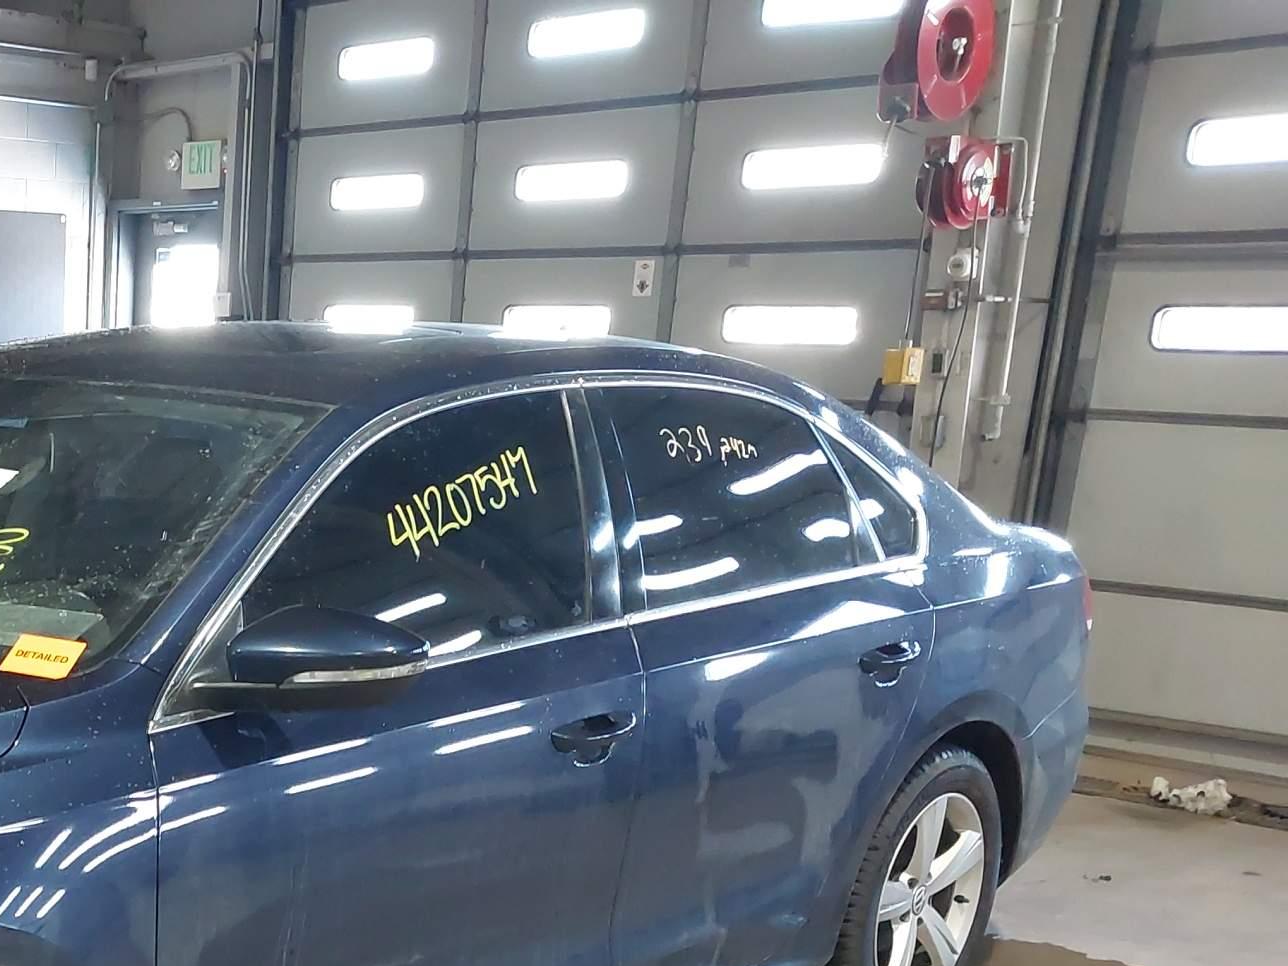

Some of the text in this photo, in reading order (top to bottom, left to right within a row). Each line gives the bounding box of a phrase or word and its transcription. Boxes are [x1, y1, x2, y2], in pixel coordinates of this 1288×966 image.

[189, 143, 215, 175] EXIT
[387, 446, 538, 562] 44207547
[15, 649, 70, 664] DETAILED
